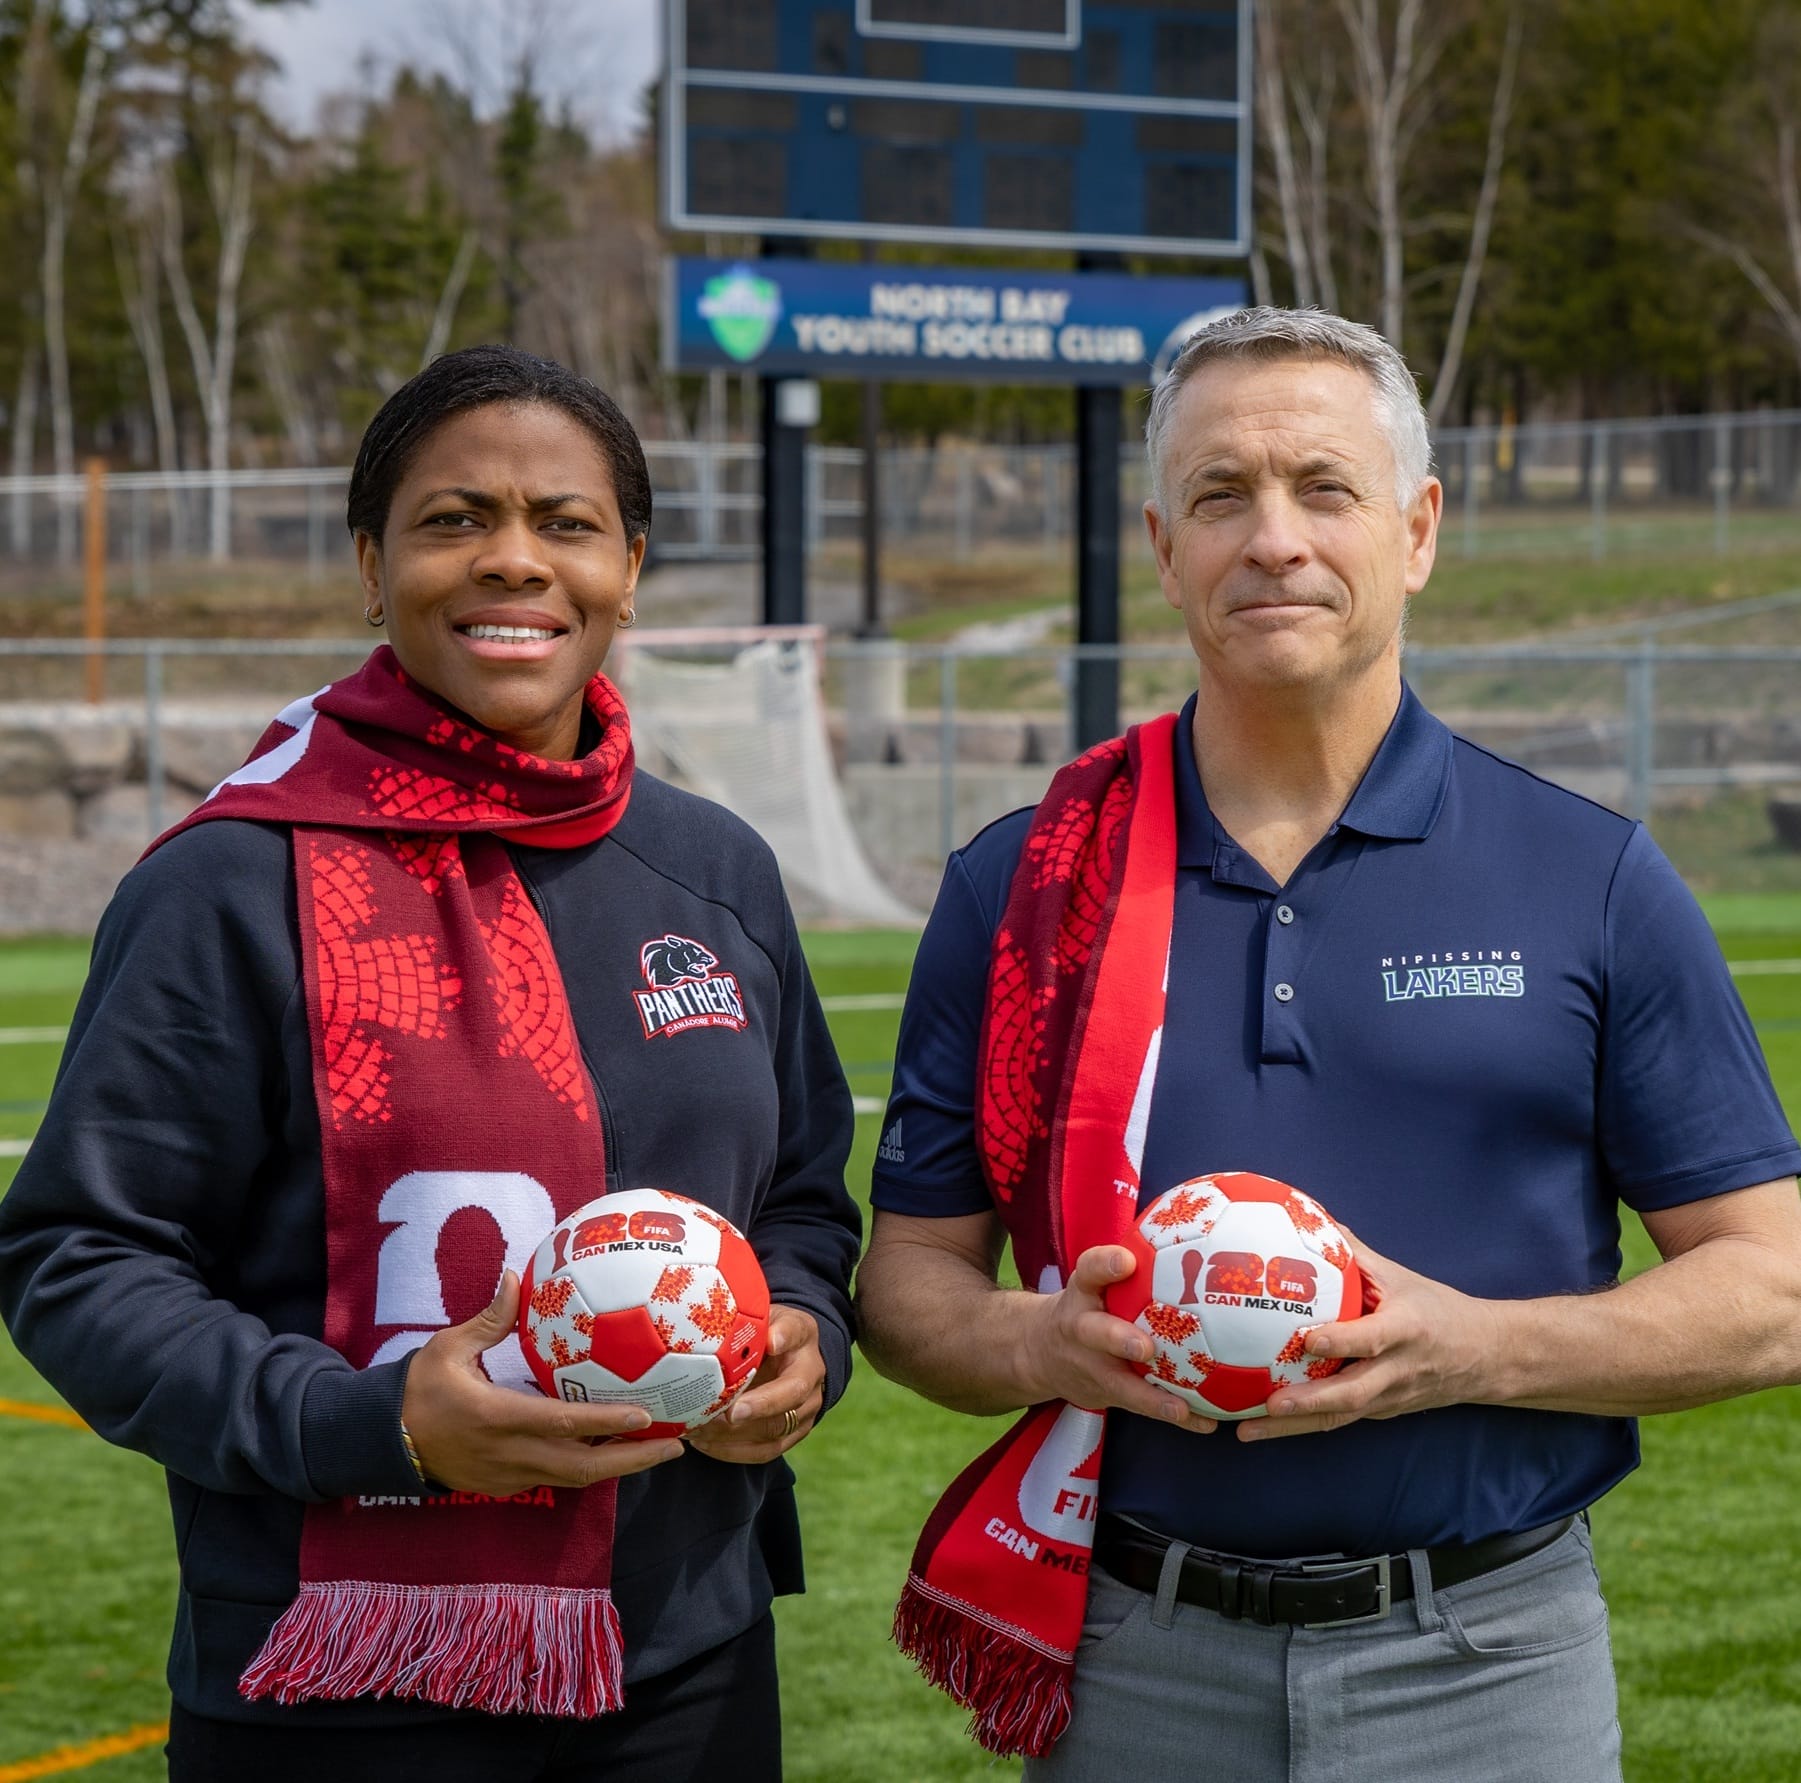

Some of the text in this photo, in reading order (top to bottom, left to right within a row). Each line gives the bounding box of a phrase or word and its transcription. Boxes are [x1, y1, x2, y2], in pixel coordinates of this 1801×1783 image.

[870, 283, 1071, 324] NORTH BAY
[791, 314, 1145, 362] YOUTH SOCCER CLUB
[1382, 951, 1521, 967] NIPISSING
[1382, 965, 1525, 1001] LAKERS
[638, 977, 745, 1032] PANTHERS
[667, 1017, 709, 1032] CANADORE
[879, 1145, 905, 1162] adidas
[643, 1225, 670, 1236] FIFA
[572, 1245, 606, 1261] CAN
[608, 1241, 645, 1253] MEX
[648, 1241, 684, 1255] USA
[1280, 1280, 1305, 1294] FIFA
[1204, 1294, 1242, 1307] CAN
[1244, 1297, 1281, 1311] MEX
[1284, 1302, 1314, 1317] USA
[1053, 1488, 1098, 1522] FI
[984, 1516, 1089, 1576] CAN ME
